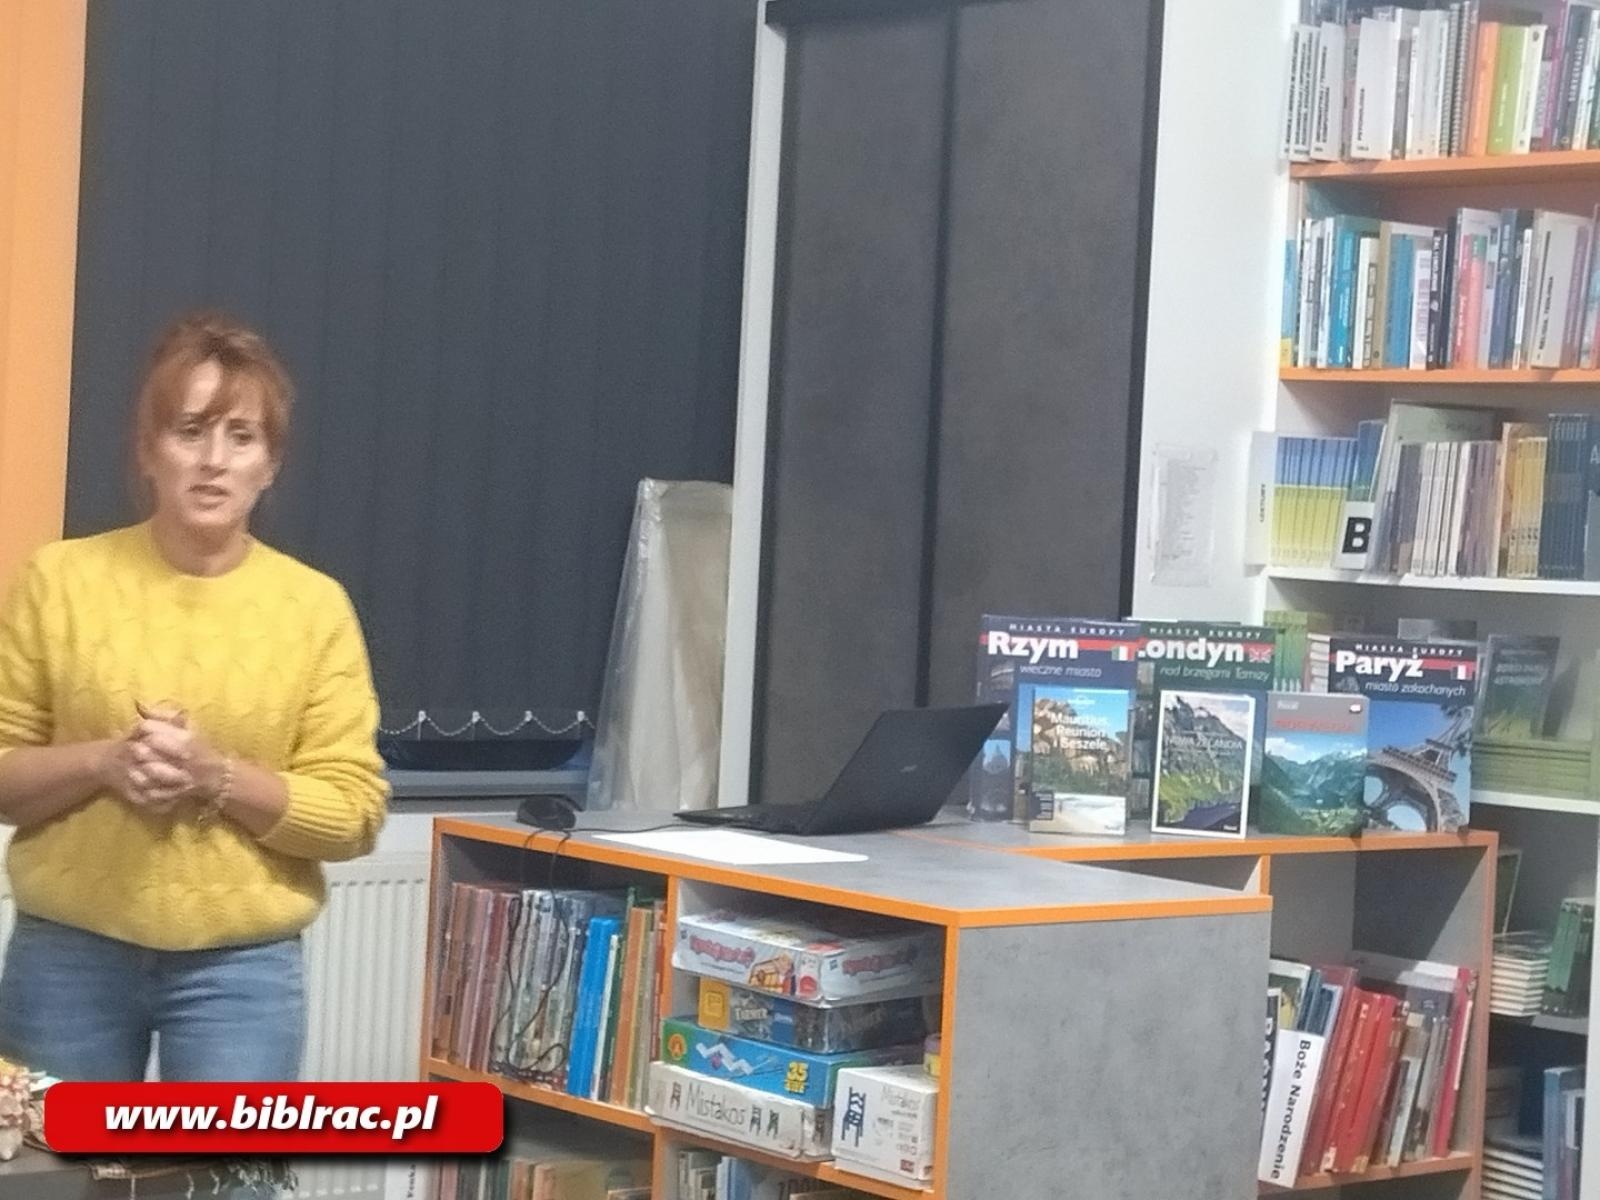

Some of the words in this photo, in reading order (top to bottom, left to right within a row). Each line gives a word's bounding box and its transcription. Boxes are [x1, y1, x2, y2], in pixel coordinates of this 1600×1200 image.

[1342, 516, 1372, 554] B
[1009, 623, 1061, 633] MIASTA
[1071, 626, 1125, 636] EUROPY
[1150, 628, 1200, 637] MIASTA
[1209, 630, 1261, 639] EUROPY
[988, 631, 1079, 664] Rzym
[1355, 644, 1403, 653] MIASTA
[1412, 647, 1463, 656] EUROPY
[1019, 665, 1063, 676] wieczne
[1065, 667, 1102, 678] miasto
[1160, 665, 1180, 676] nad
[1336, 650, 1424, 682] Paryż
[1365, 681, 1399, 693] miasto
[1401, 683, 1466, 698] zakochanych
[1293, 1039, 1311, 1079] Boże
[687, 1081, 746, 1126] Mistakos
[1270, 1084, 1302, 1180] Narodzenie
